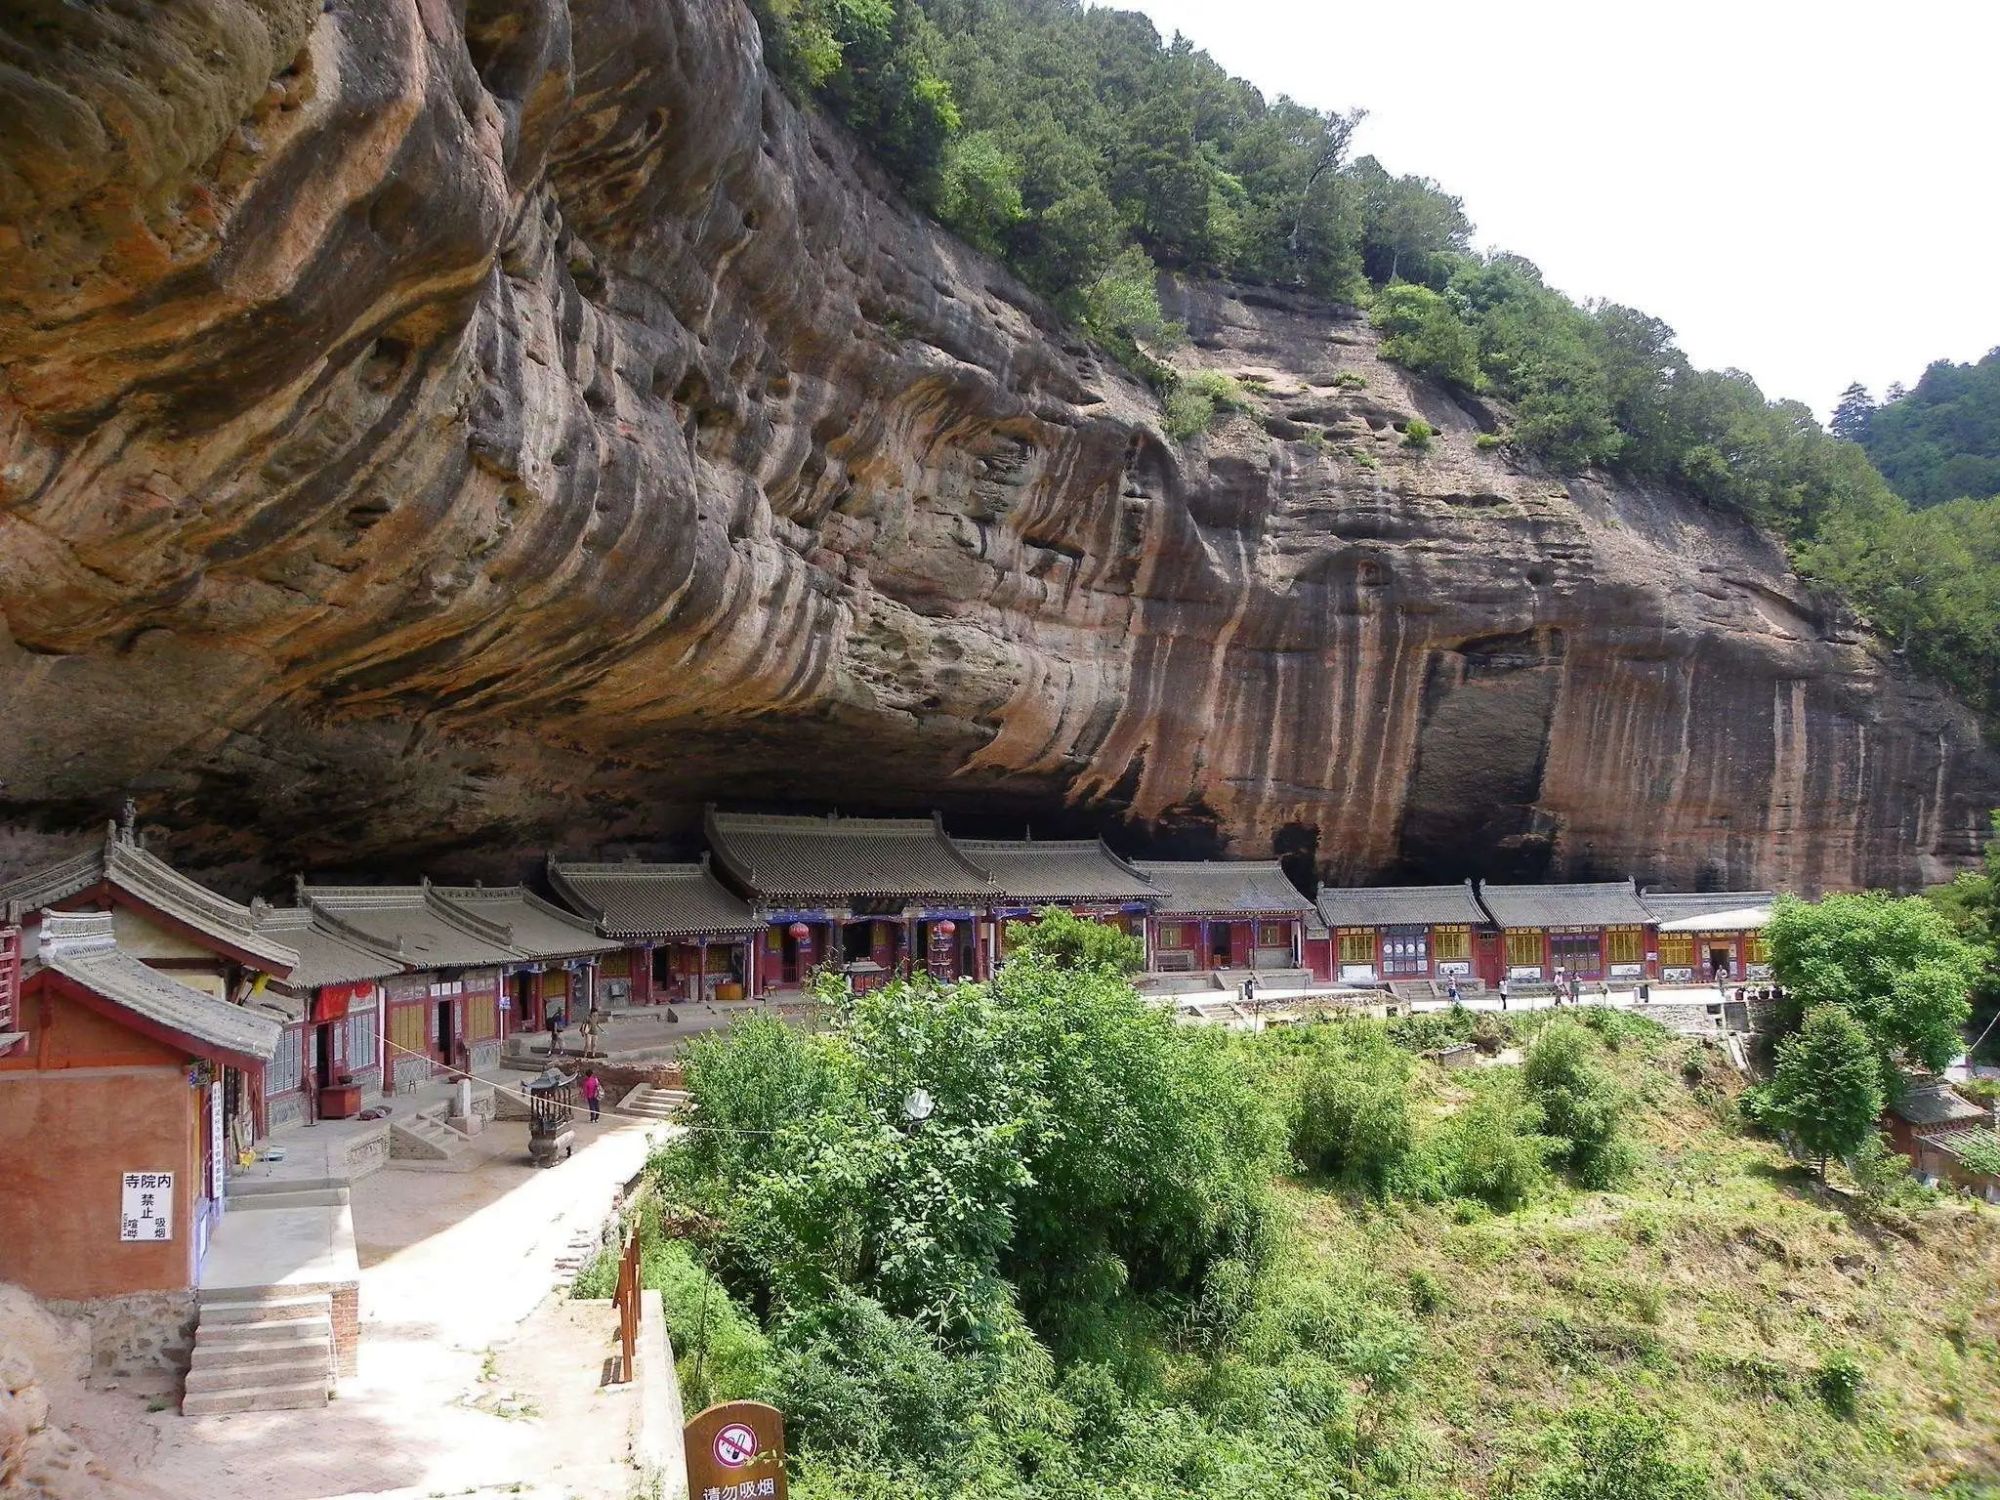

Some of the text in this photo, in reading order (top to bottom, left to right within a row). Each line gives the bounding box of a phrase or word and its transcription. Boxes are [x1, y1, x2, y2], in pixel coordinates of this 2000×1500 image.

[125, 1174, 171, 1189] 寺院内
[141, 1193, 155, 1219] 禁止
[127, 1218, 139, 1239] 喧哗
[154, 1217, 166, 1238] 吸烟
[703, 1478, 775, 1500] 请勿吸烟
